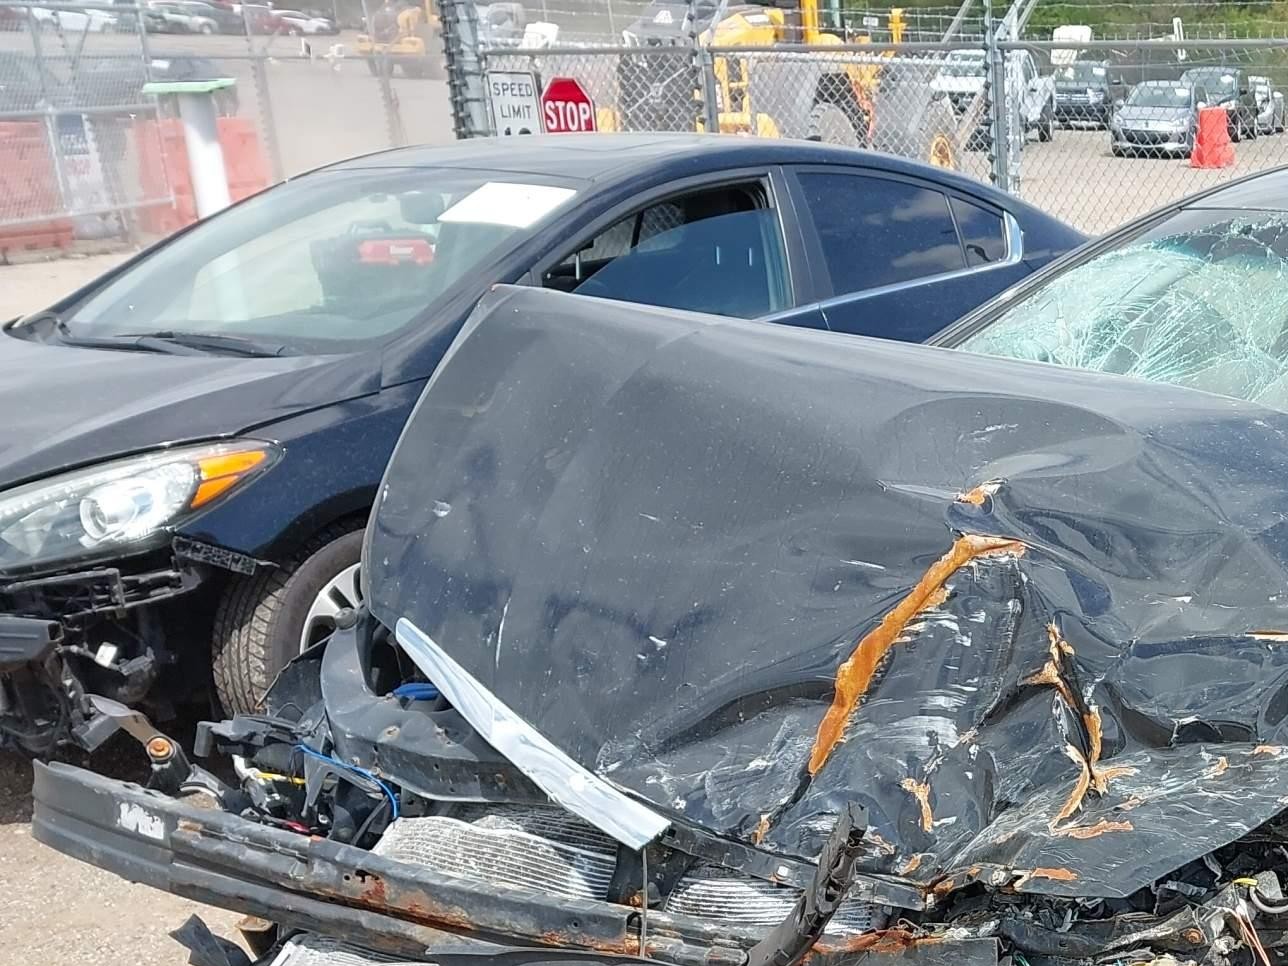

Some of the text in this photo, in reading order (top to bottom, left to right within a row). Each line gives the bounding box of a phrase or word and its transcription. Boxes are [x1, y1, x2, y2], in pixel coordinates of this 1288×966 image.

[493, 82, 533, 97] SPEED
[500, 104, 532, 119] LIMIT
[545, 100, 591, 131] STOP
